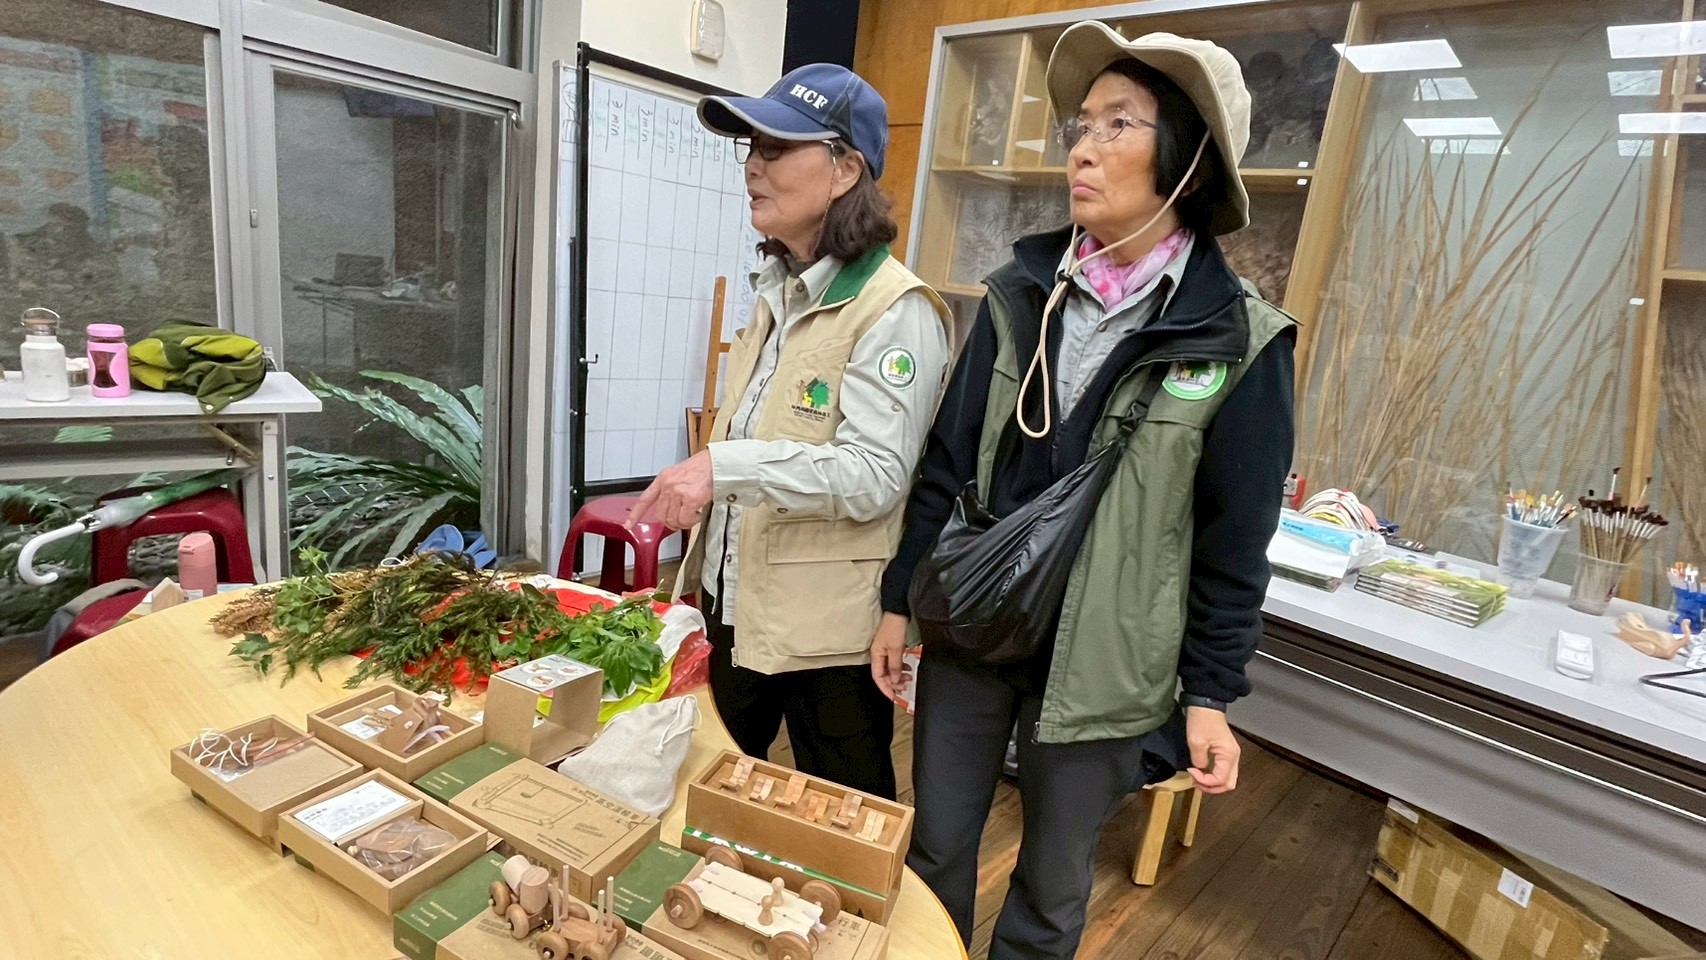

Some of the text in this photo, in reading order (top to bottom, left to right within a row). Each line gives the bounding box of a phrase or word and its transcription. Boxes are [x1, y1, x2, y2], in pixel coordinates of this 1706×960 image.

[789, 84, 829, 109] HCF
[611, 115, 621, 137] min
[641, 118, 650, 142] min
[668, 130, 676, 154] min
[691, 138, 699, 159] min
